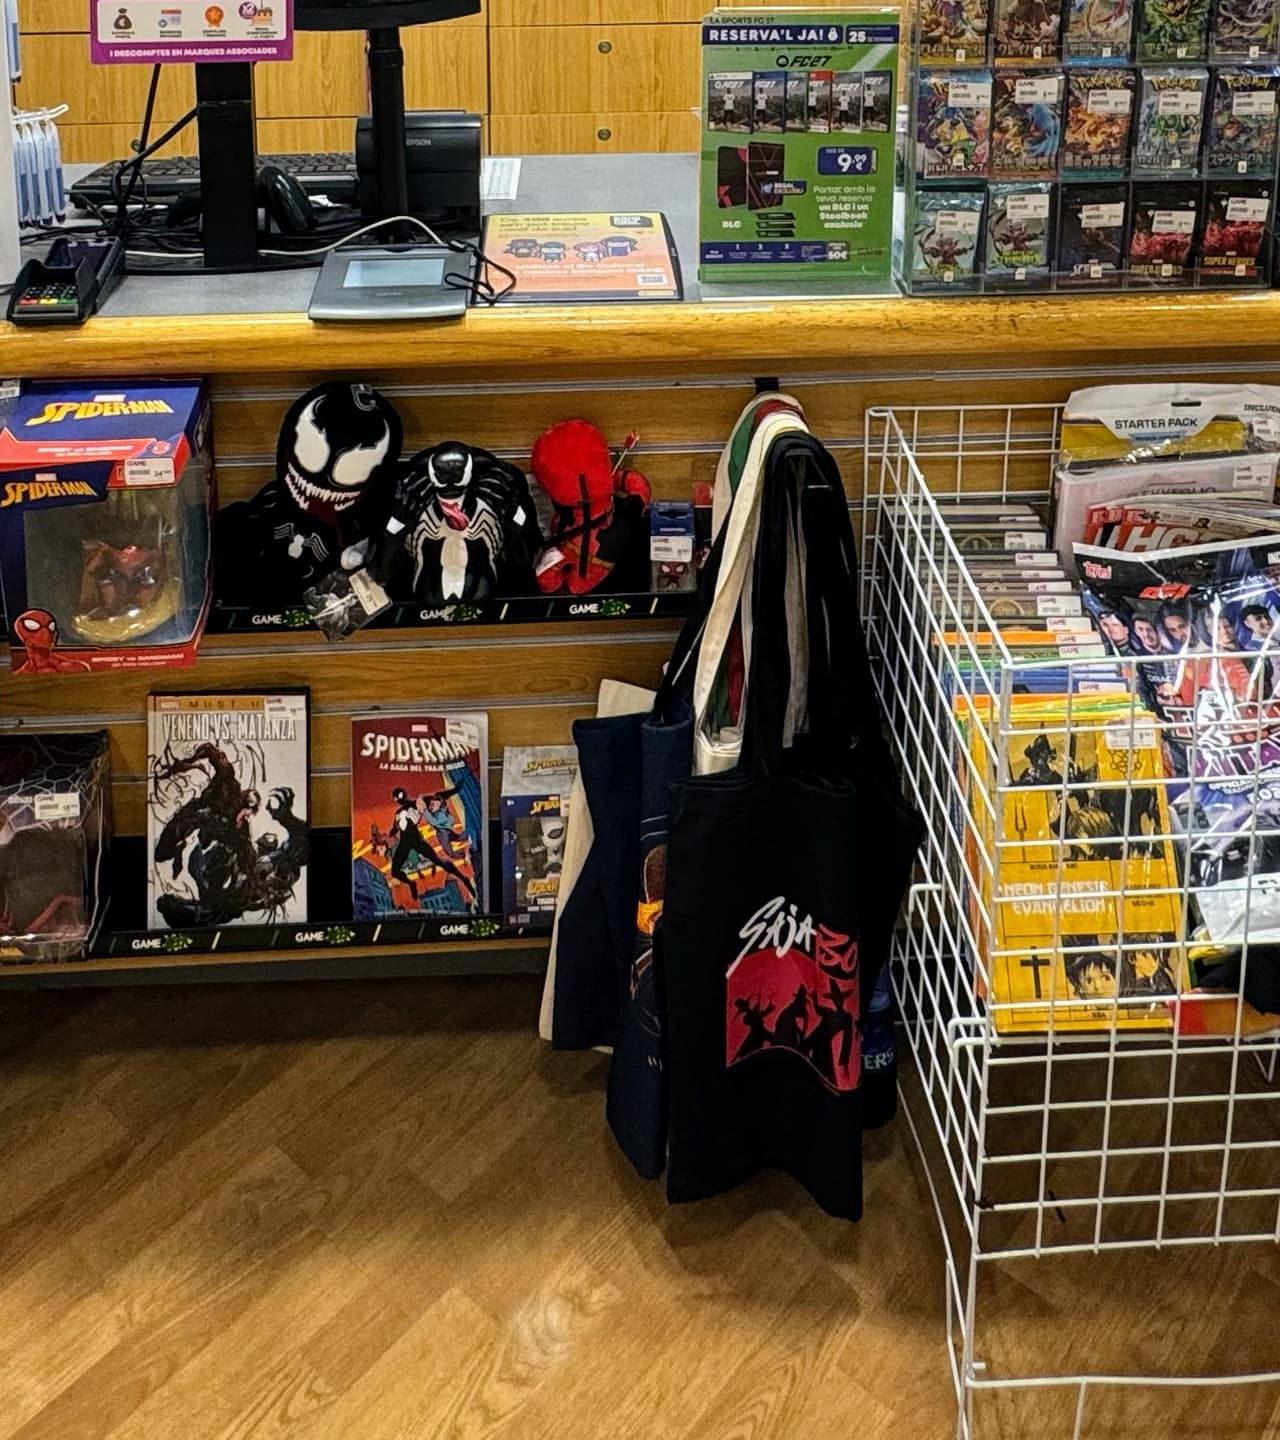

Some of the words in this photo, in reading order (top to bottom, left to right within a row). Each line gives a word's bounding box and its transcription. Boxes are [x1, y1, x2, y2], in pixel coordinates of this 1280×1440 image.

[721, 17, 751, 25] SPORTS
[709, 28, 794, 42] RESERVA'L
[797, 28, 824, 42] JA!
[849, 31, 866, 44] 25
[114, 48, 171, 58] DESCOMPTES
[172, 48, 183, 57] EN
[184, 47, 225, 57] MARQUES
[226, 46, 278, 56] ASSOCIADES
[1115, 418, 1166, 430] STARTER
[1169, 417, 1198, 428] PACK
[569, 602, 599, 615] GAME
[252, 614, 282, 626] GAME
[162, 714, 210, 741] VENENO
[214, 714, 233, 741] VS.
[237, 713, 297, 741] MATANZA
[440, 923, 469, 936] GAME
[295, 930, 324, 943] GAME
[132, 937, 161, 950] GAME
